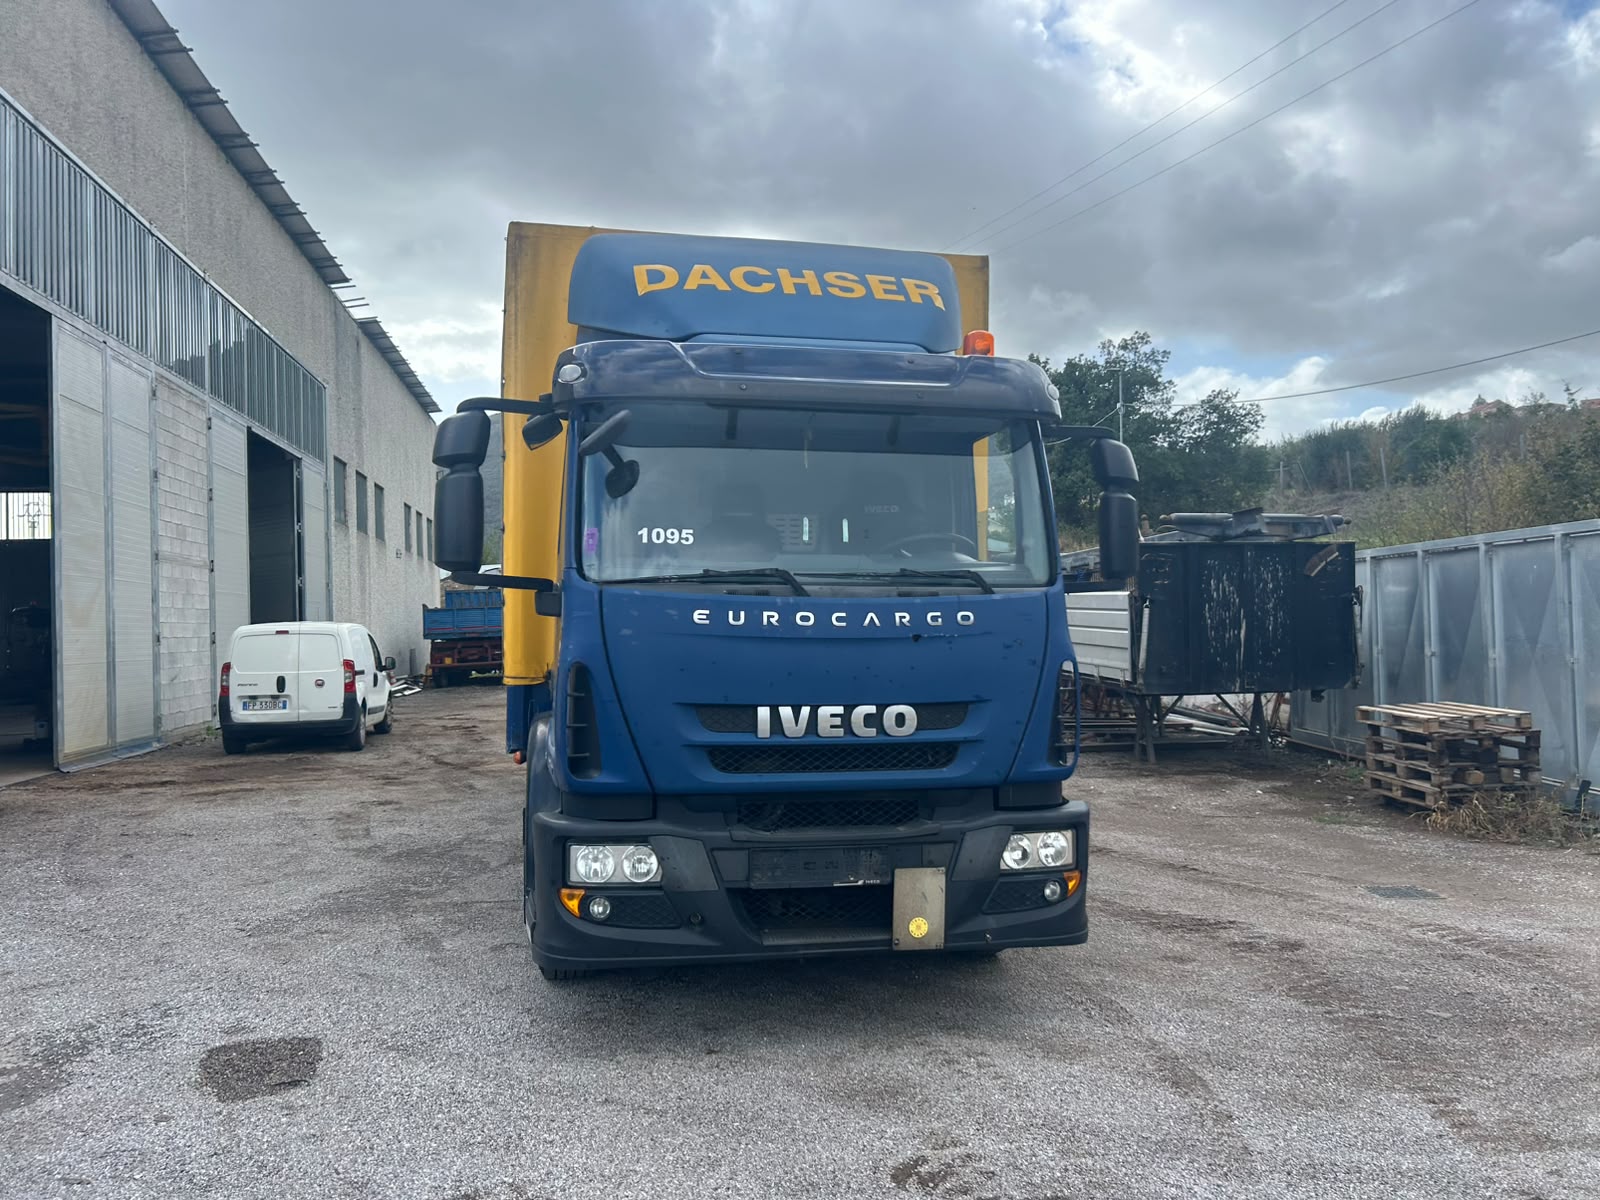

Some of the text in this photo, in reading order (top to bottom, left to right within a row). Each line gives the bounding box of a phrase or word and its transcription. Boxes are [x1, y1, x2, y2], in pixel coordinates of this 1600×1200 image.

[632, 264, 946, 312] DACHSER
[637, 527, 695, 545] 1095
[692, 609, 976, 627] EUROCARGO
[756, 704, 918, 738] IVECO
